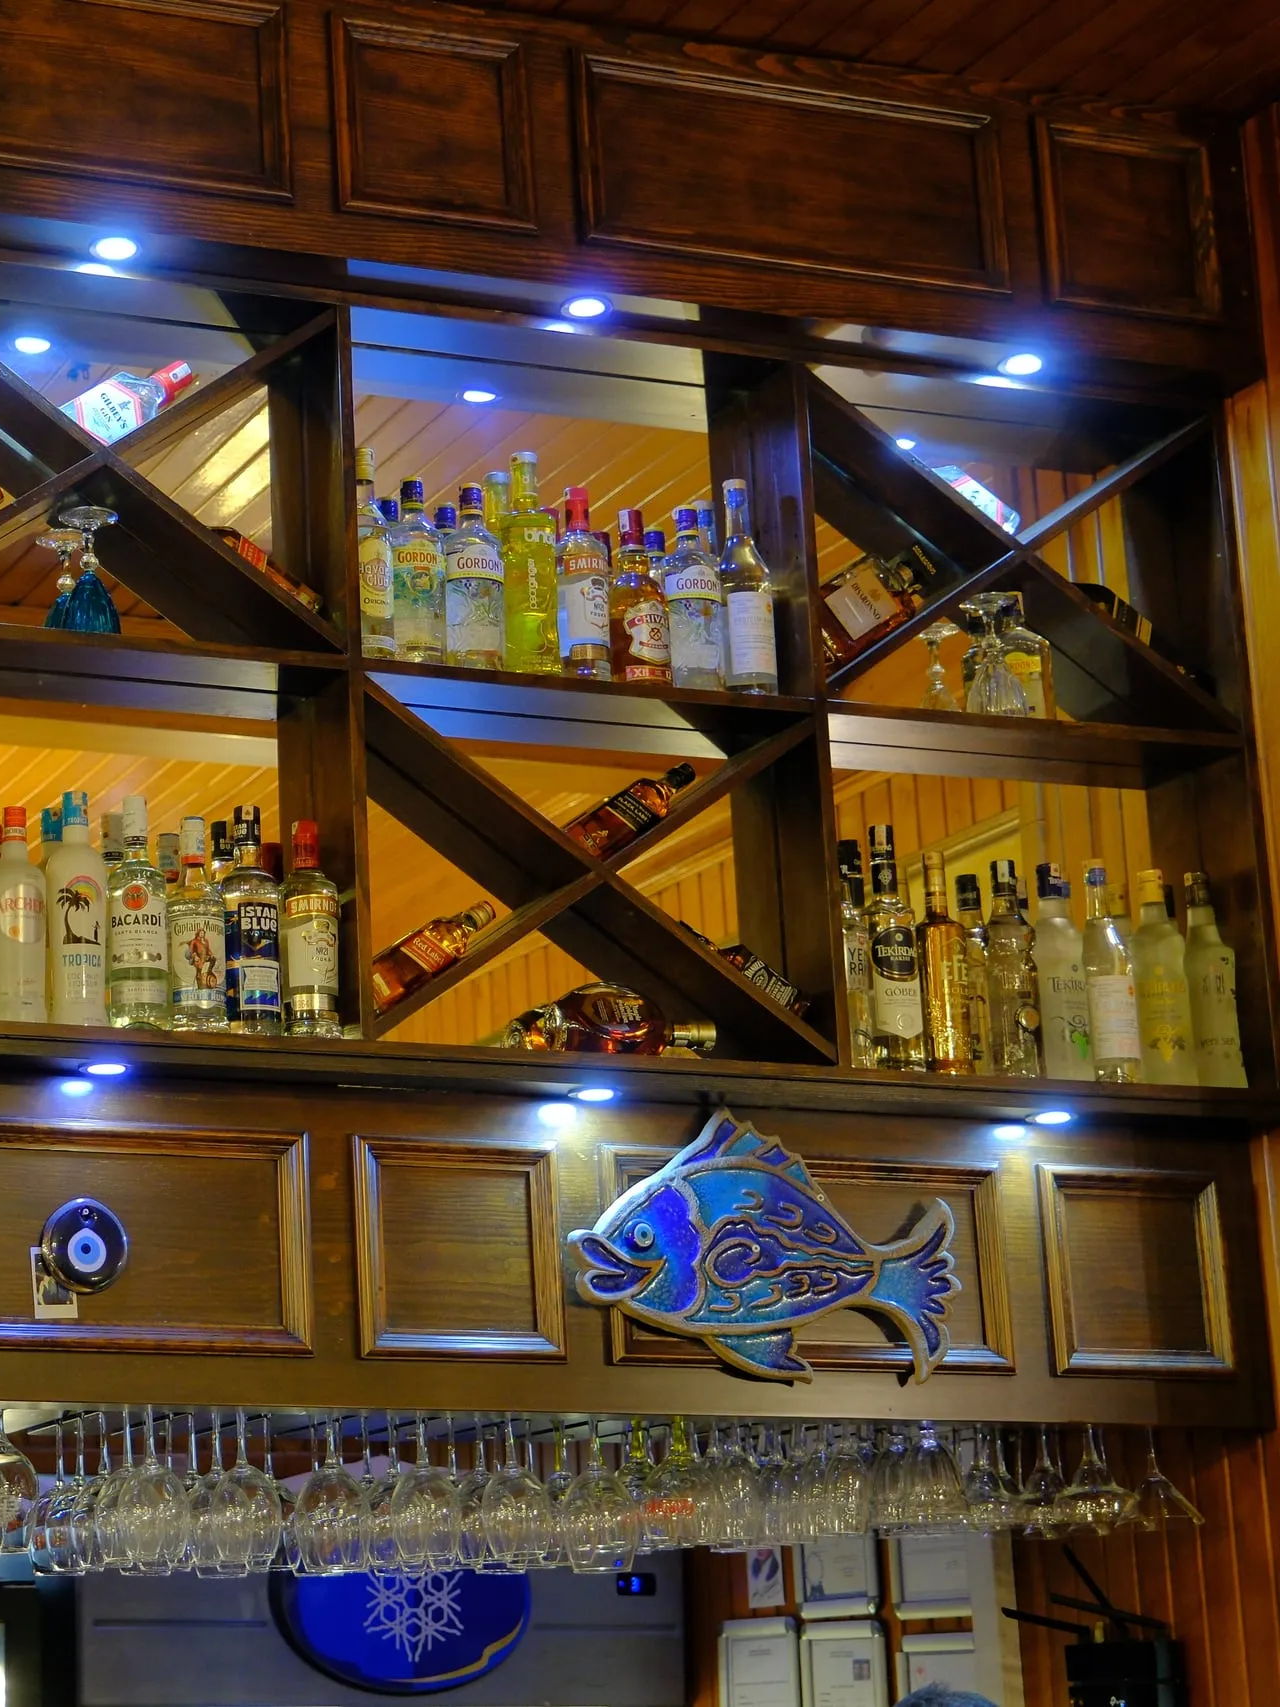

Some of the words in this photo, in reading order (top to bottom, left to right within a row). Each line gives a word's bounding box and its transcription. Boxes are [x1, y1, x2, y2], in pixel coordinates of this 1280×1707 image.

[99, 407, 111, 423] GIN
[100, 392, 128, 430] GILBEY'S
[851, 581, 882, 621] DISARONNO
[112, 912, 161, 929] BACARDÍ
[174, 920, 201, 937] Captain
[413, 937, 427, 950] Red
[426, 948, 444, 964] Label
